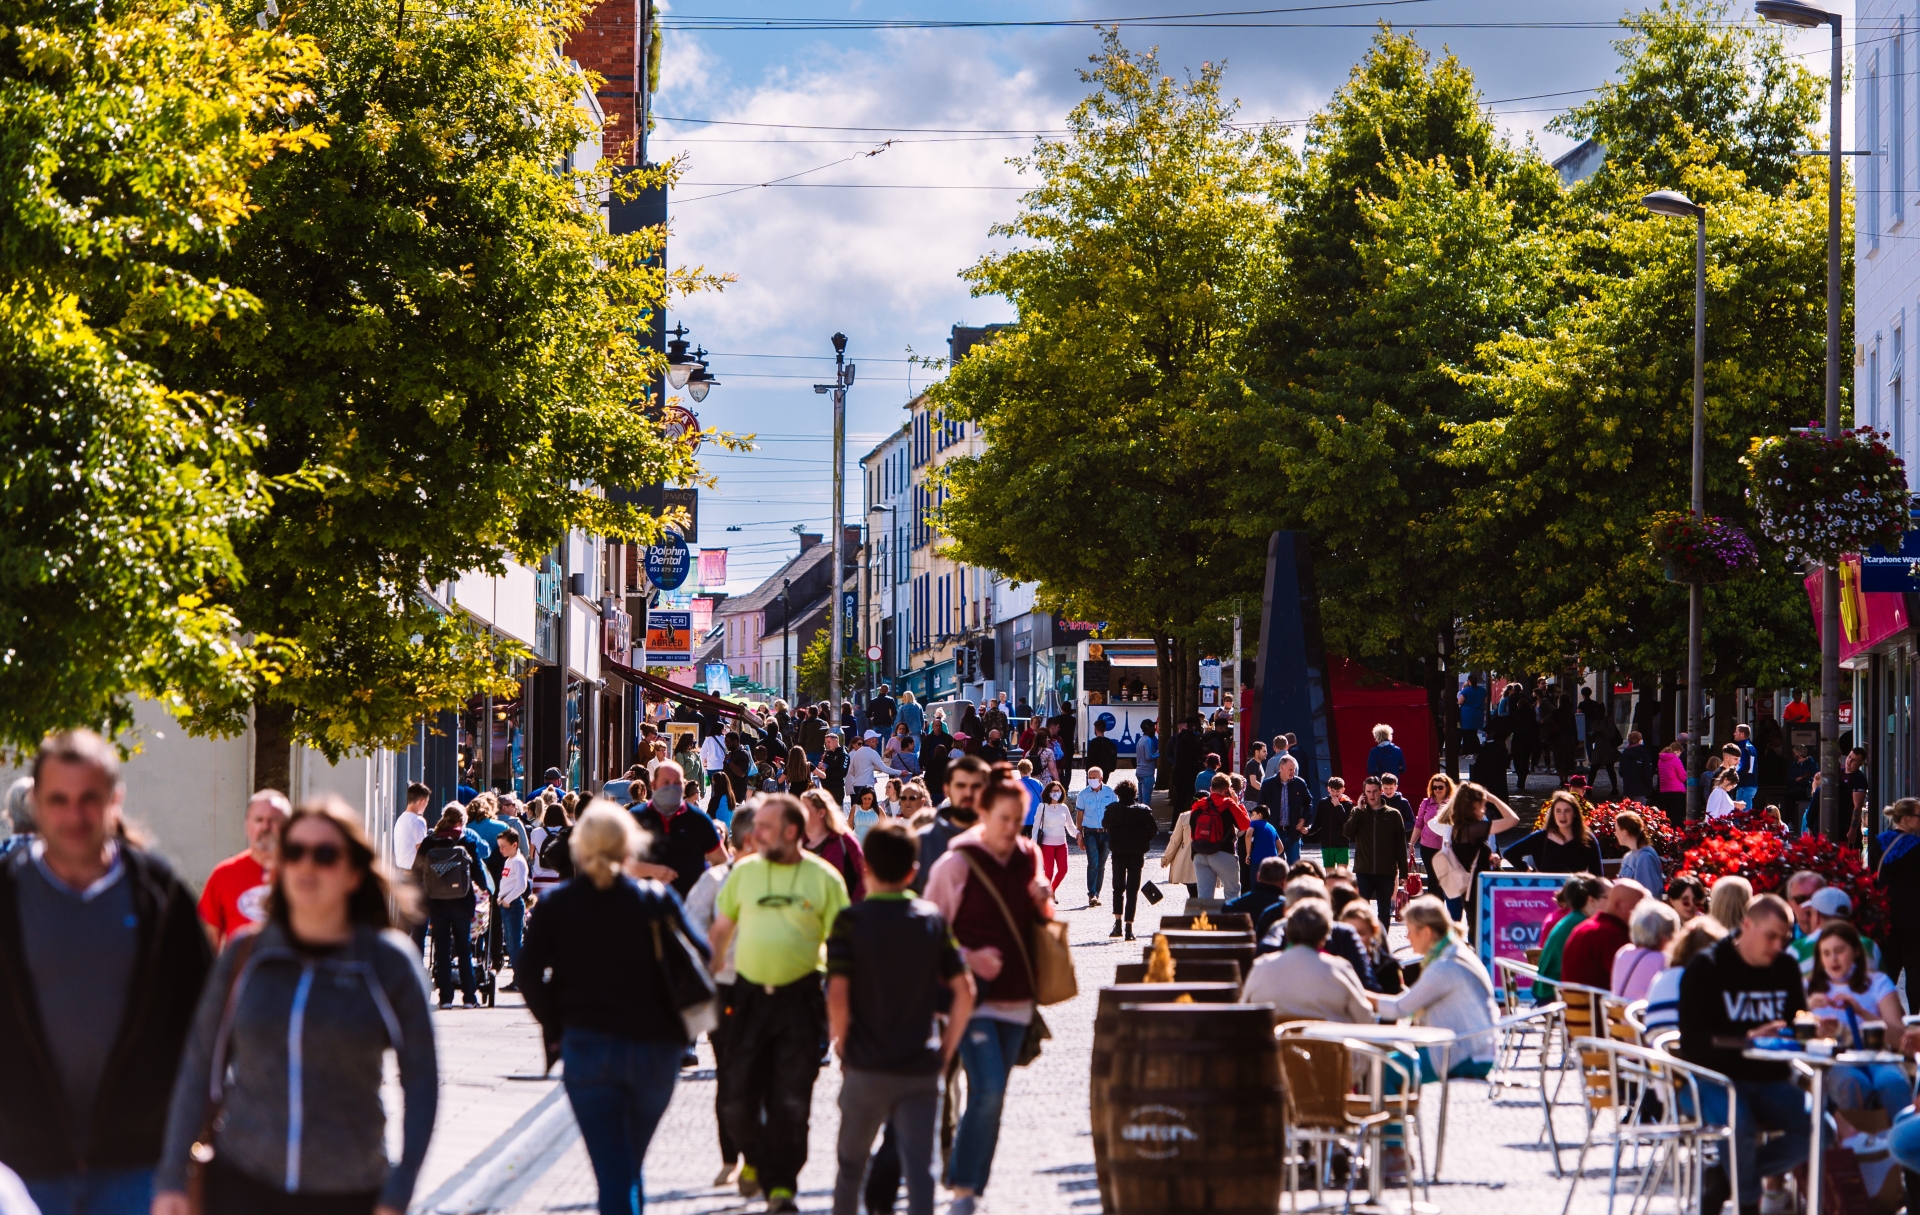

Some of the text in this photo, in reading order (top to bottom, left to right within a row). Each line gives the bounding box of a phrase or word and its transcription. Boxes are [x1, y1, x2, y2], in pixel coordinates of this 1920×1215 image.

[650, 545, 686, 557] Dolphin
[650, 555, 682, 565] Dental
[1867, 556, 1902, 564] Carphone
[651, 639, 683, 647] AGREED
[1504, 899, 1549, 908] carters.
[1501, 926, 1540, 942] LOV
[1722, 990, 1788, 1021] VANS
